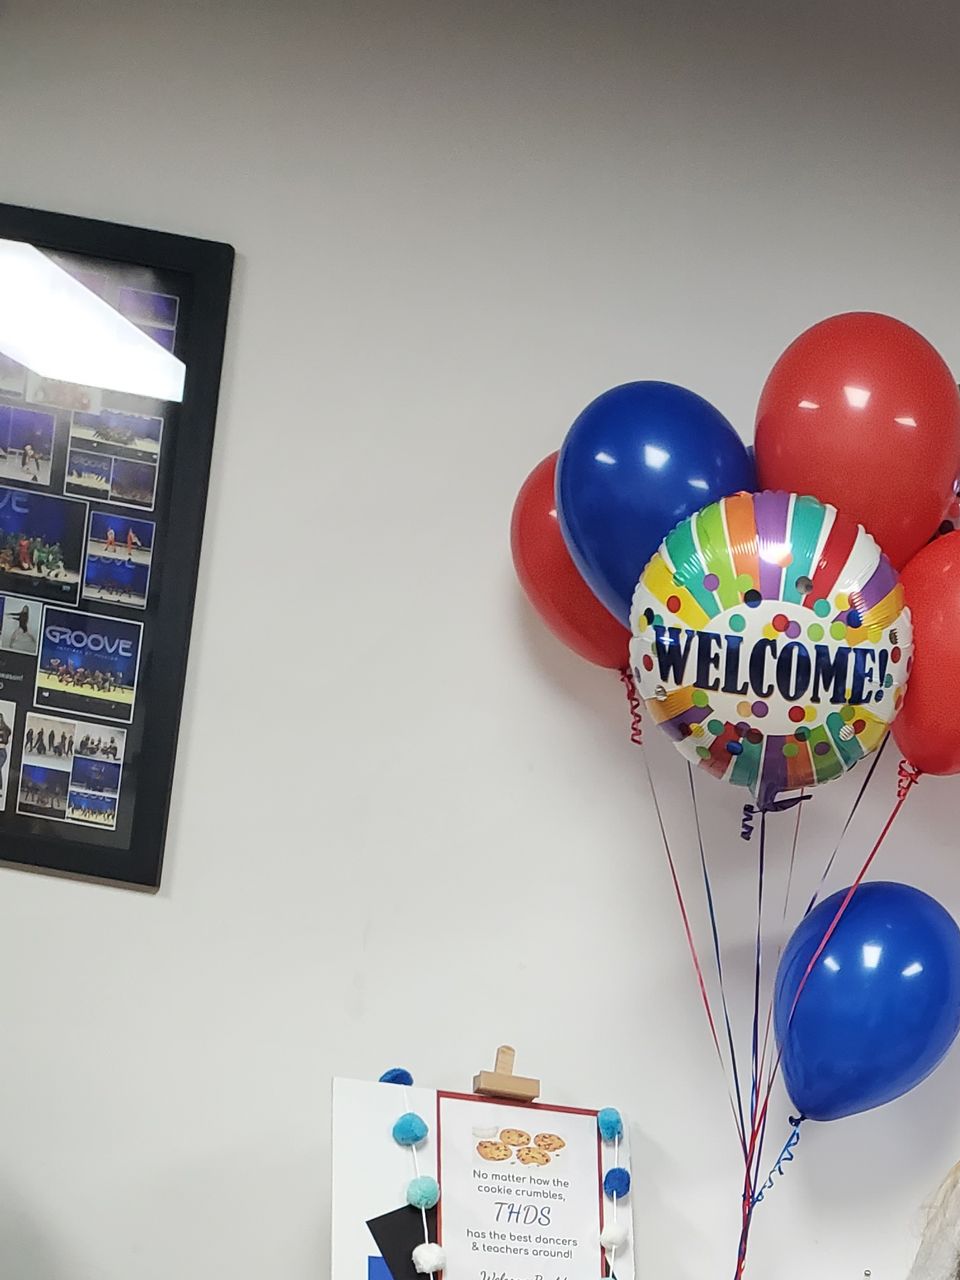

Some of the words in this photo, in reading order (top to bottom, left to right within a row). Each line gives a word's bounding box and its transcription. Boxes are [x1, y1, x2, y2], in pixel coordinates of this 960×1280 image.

[45, 625, 133, 657] GROOVE
[654, 625, 889, 706] WELCOME!
[473, 1169, 488, 1180] No
[492, 1171, 526, 1184] matter
[530, 1176, 549, 1186] how
[553, 1178, 569, 1188] the
[478, 1184, 512, 1195] cookie
[515, 1188, 566, 1201] crumbles,
[494, 1202, 551, 1226] THDS
[467, 1229, 486, 1239] has
[489, 1231, 506, 1241] the
[510, 1232, 532, 1243] best
[535, 1235, 577, 1246] dancers
[472, 1242, 479, 1250] &
[482, 1243, 529, 1256] teachers
[532, 1248, 572, 1258] around!
